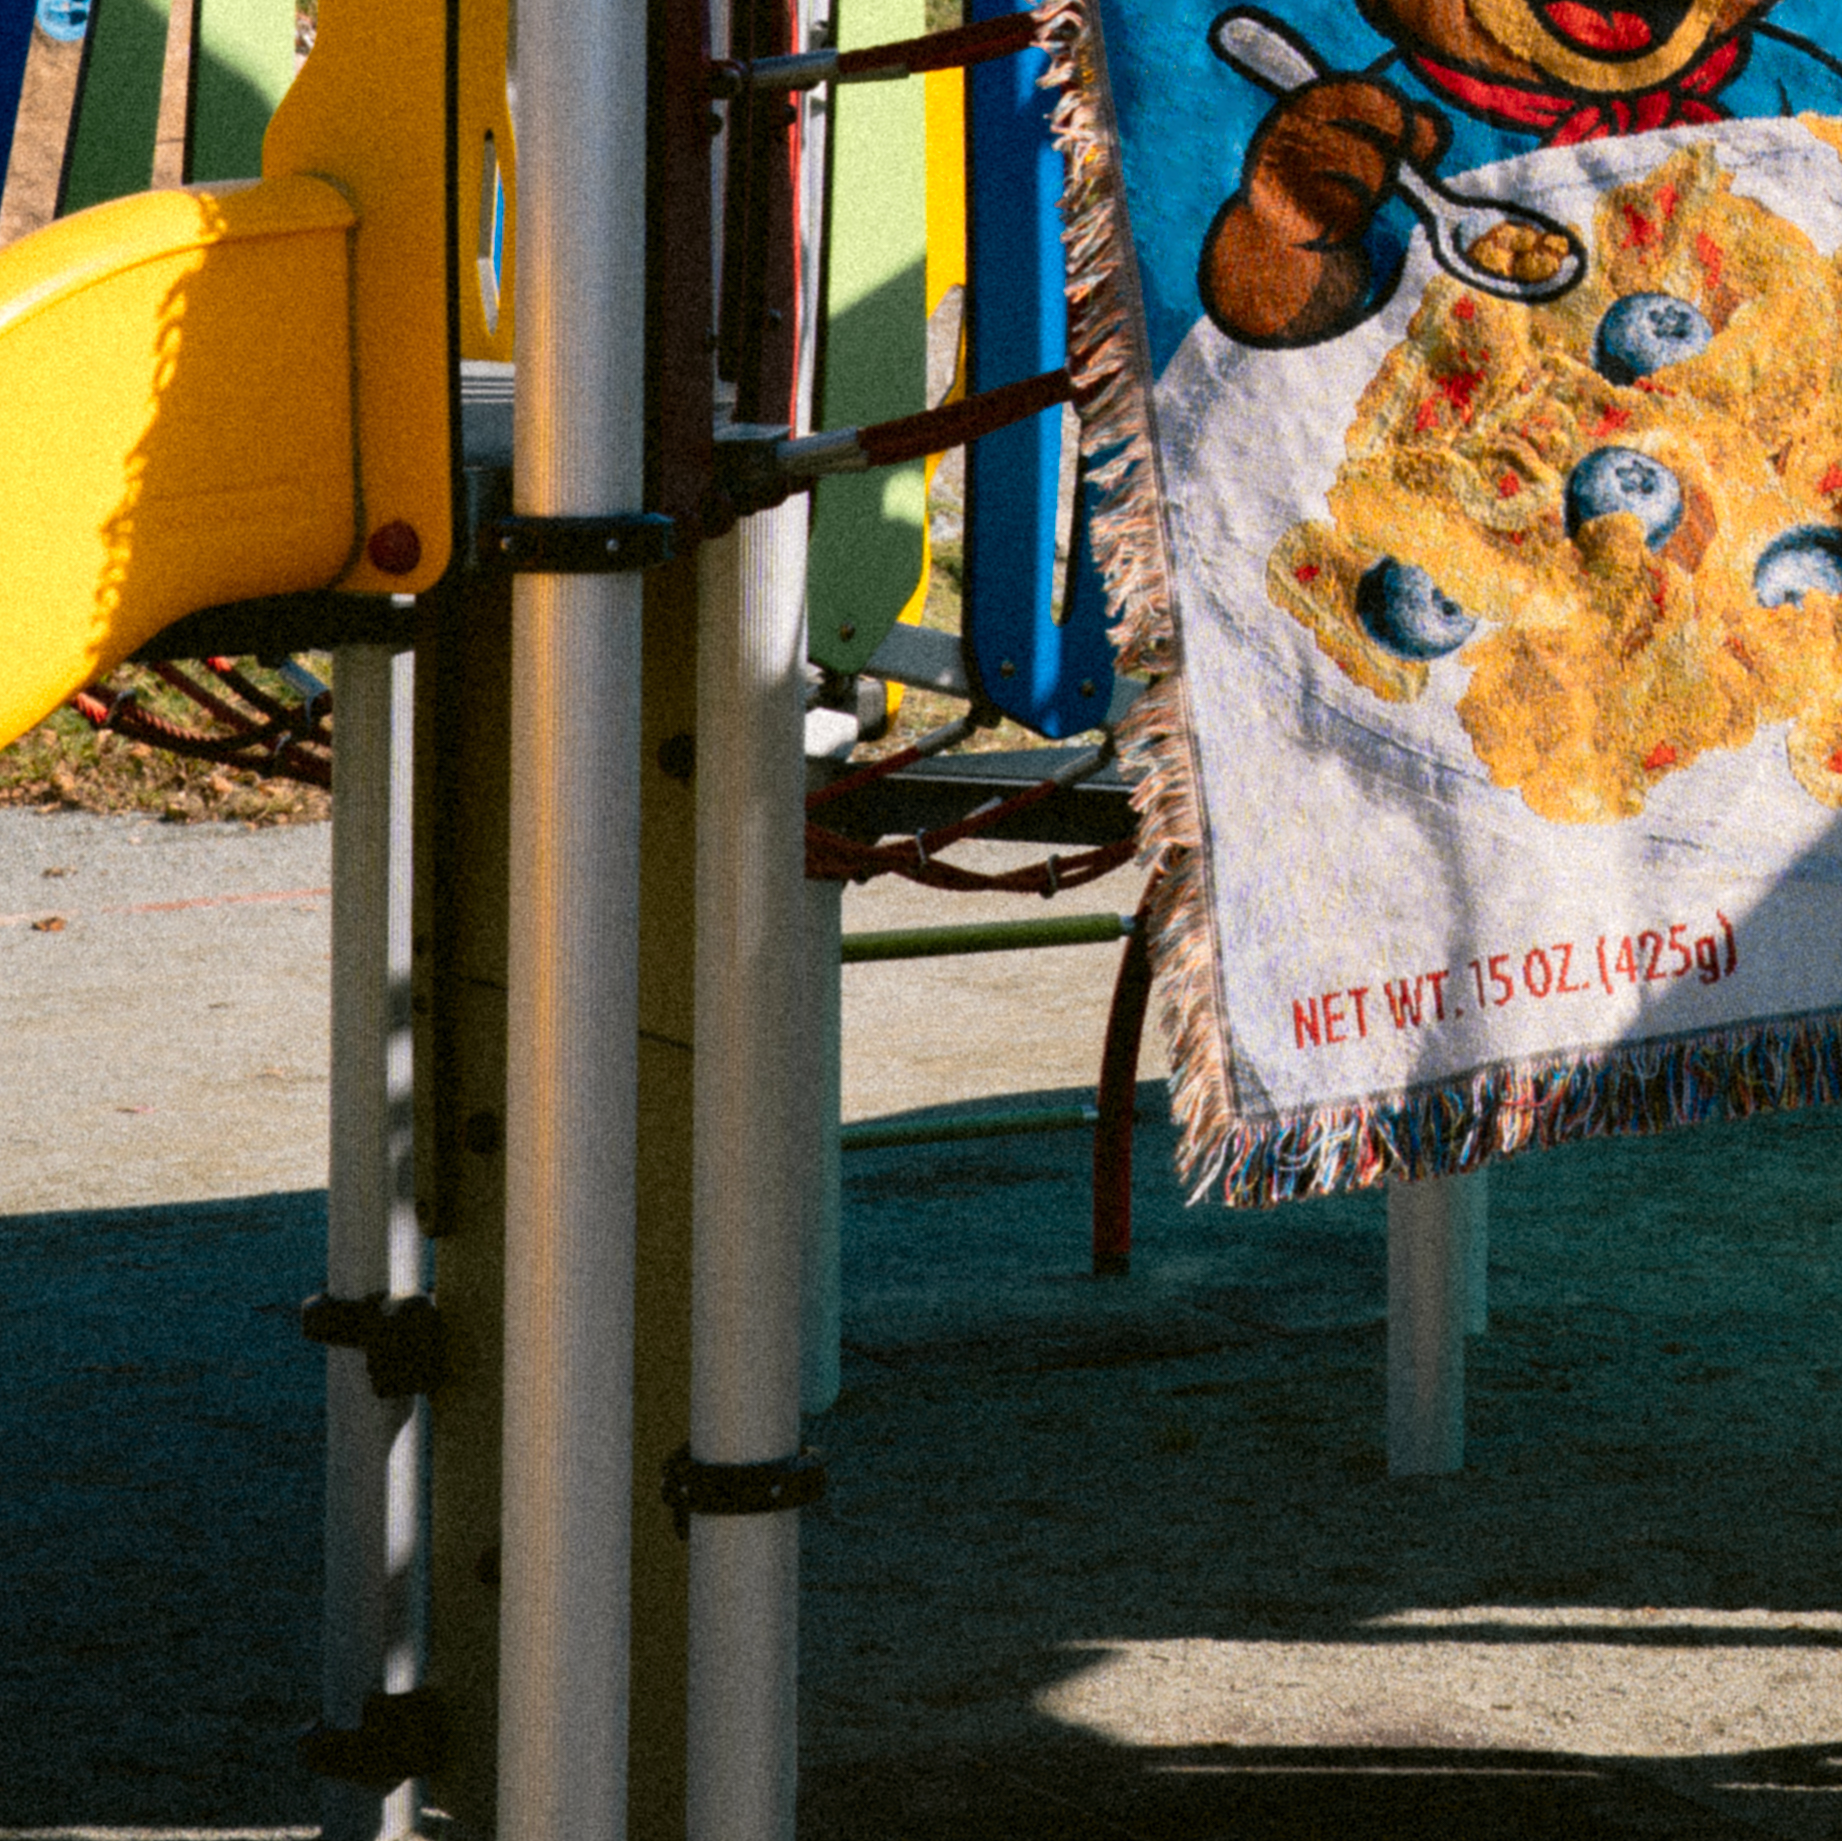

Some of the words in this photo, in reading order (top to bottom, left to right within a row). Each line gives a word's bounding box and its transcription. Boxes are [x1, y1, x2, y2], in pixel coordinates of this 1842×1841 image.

[1291, 985, 1370, 1050] NET
[1383, 969, 1465, 1030] WT.
[1469, 953, 1515, 1010] 15
[1522, 942, 1591, 1000] OZ.
[1595, 908, 1738, 995] (425g)
